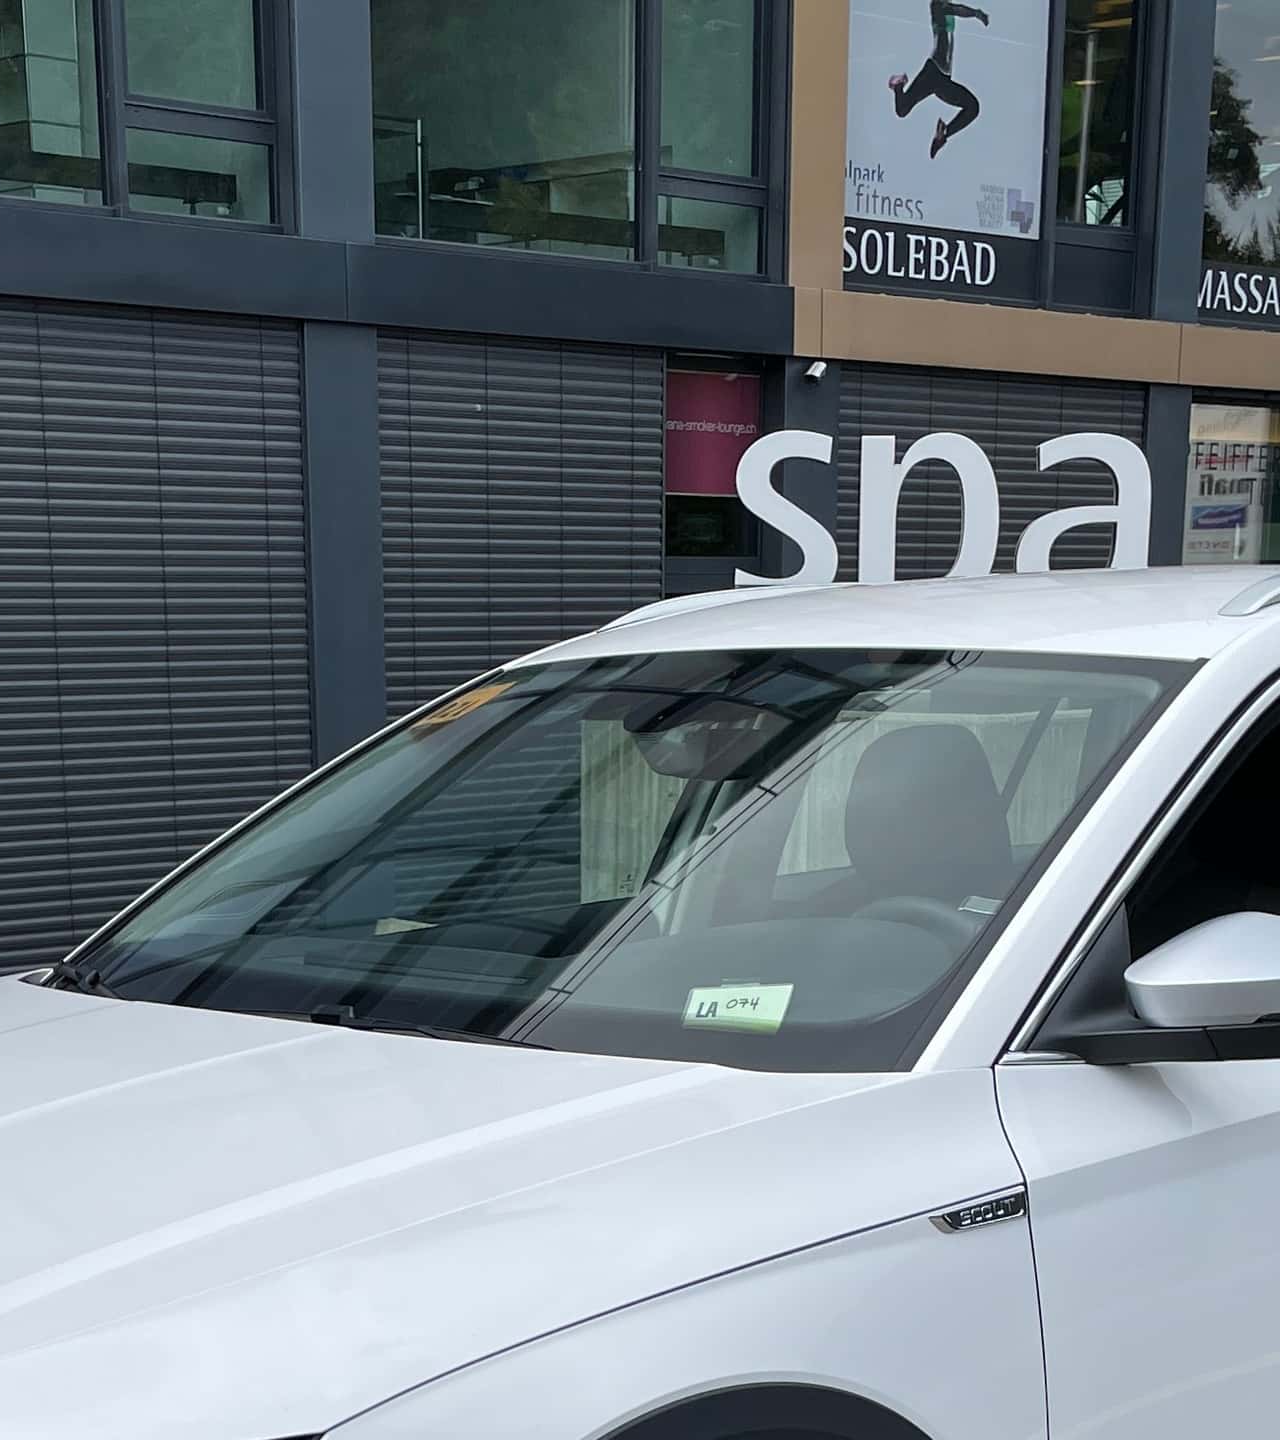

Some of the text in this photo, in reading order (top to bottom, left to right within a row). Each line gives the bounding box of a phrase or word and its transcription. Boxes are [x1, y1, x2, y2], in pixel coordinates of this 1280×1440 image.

[856, 184, 925, 220] fitness
[842, 226, 997, 286] SOLEBAD
[696, 1001, 719, 1018] LA
[726, 997, 760, 1011] 074
[960, 1198, 1016, 1226] SCOUT
